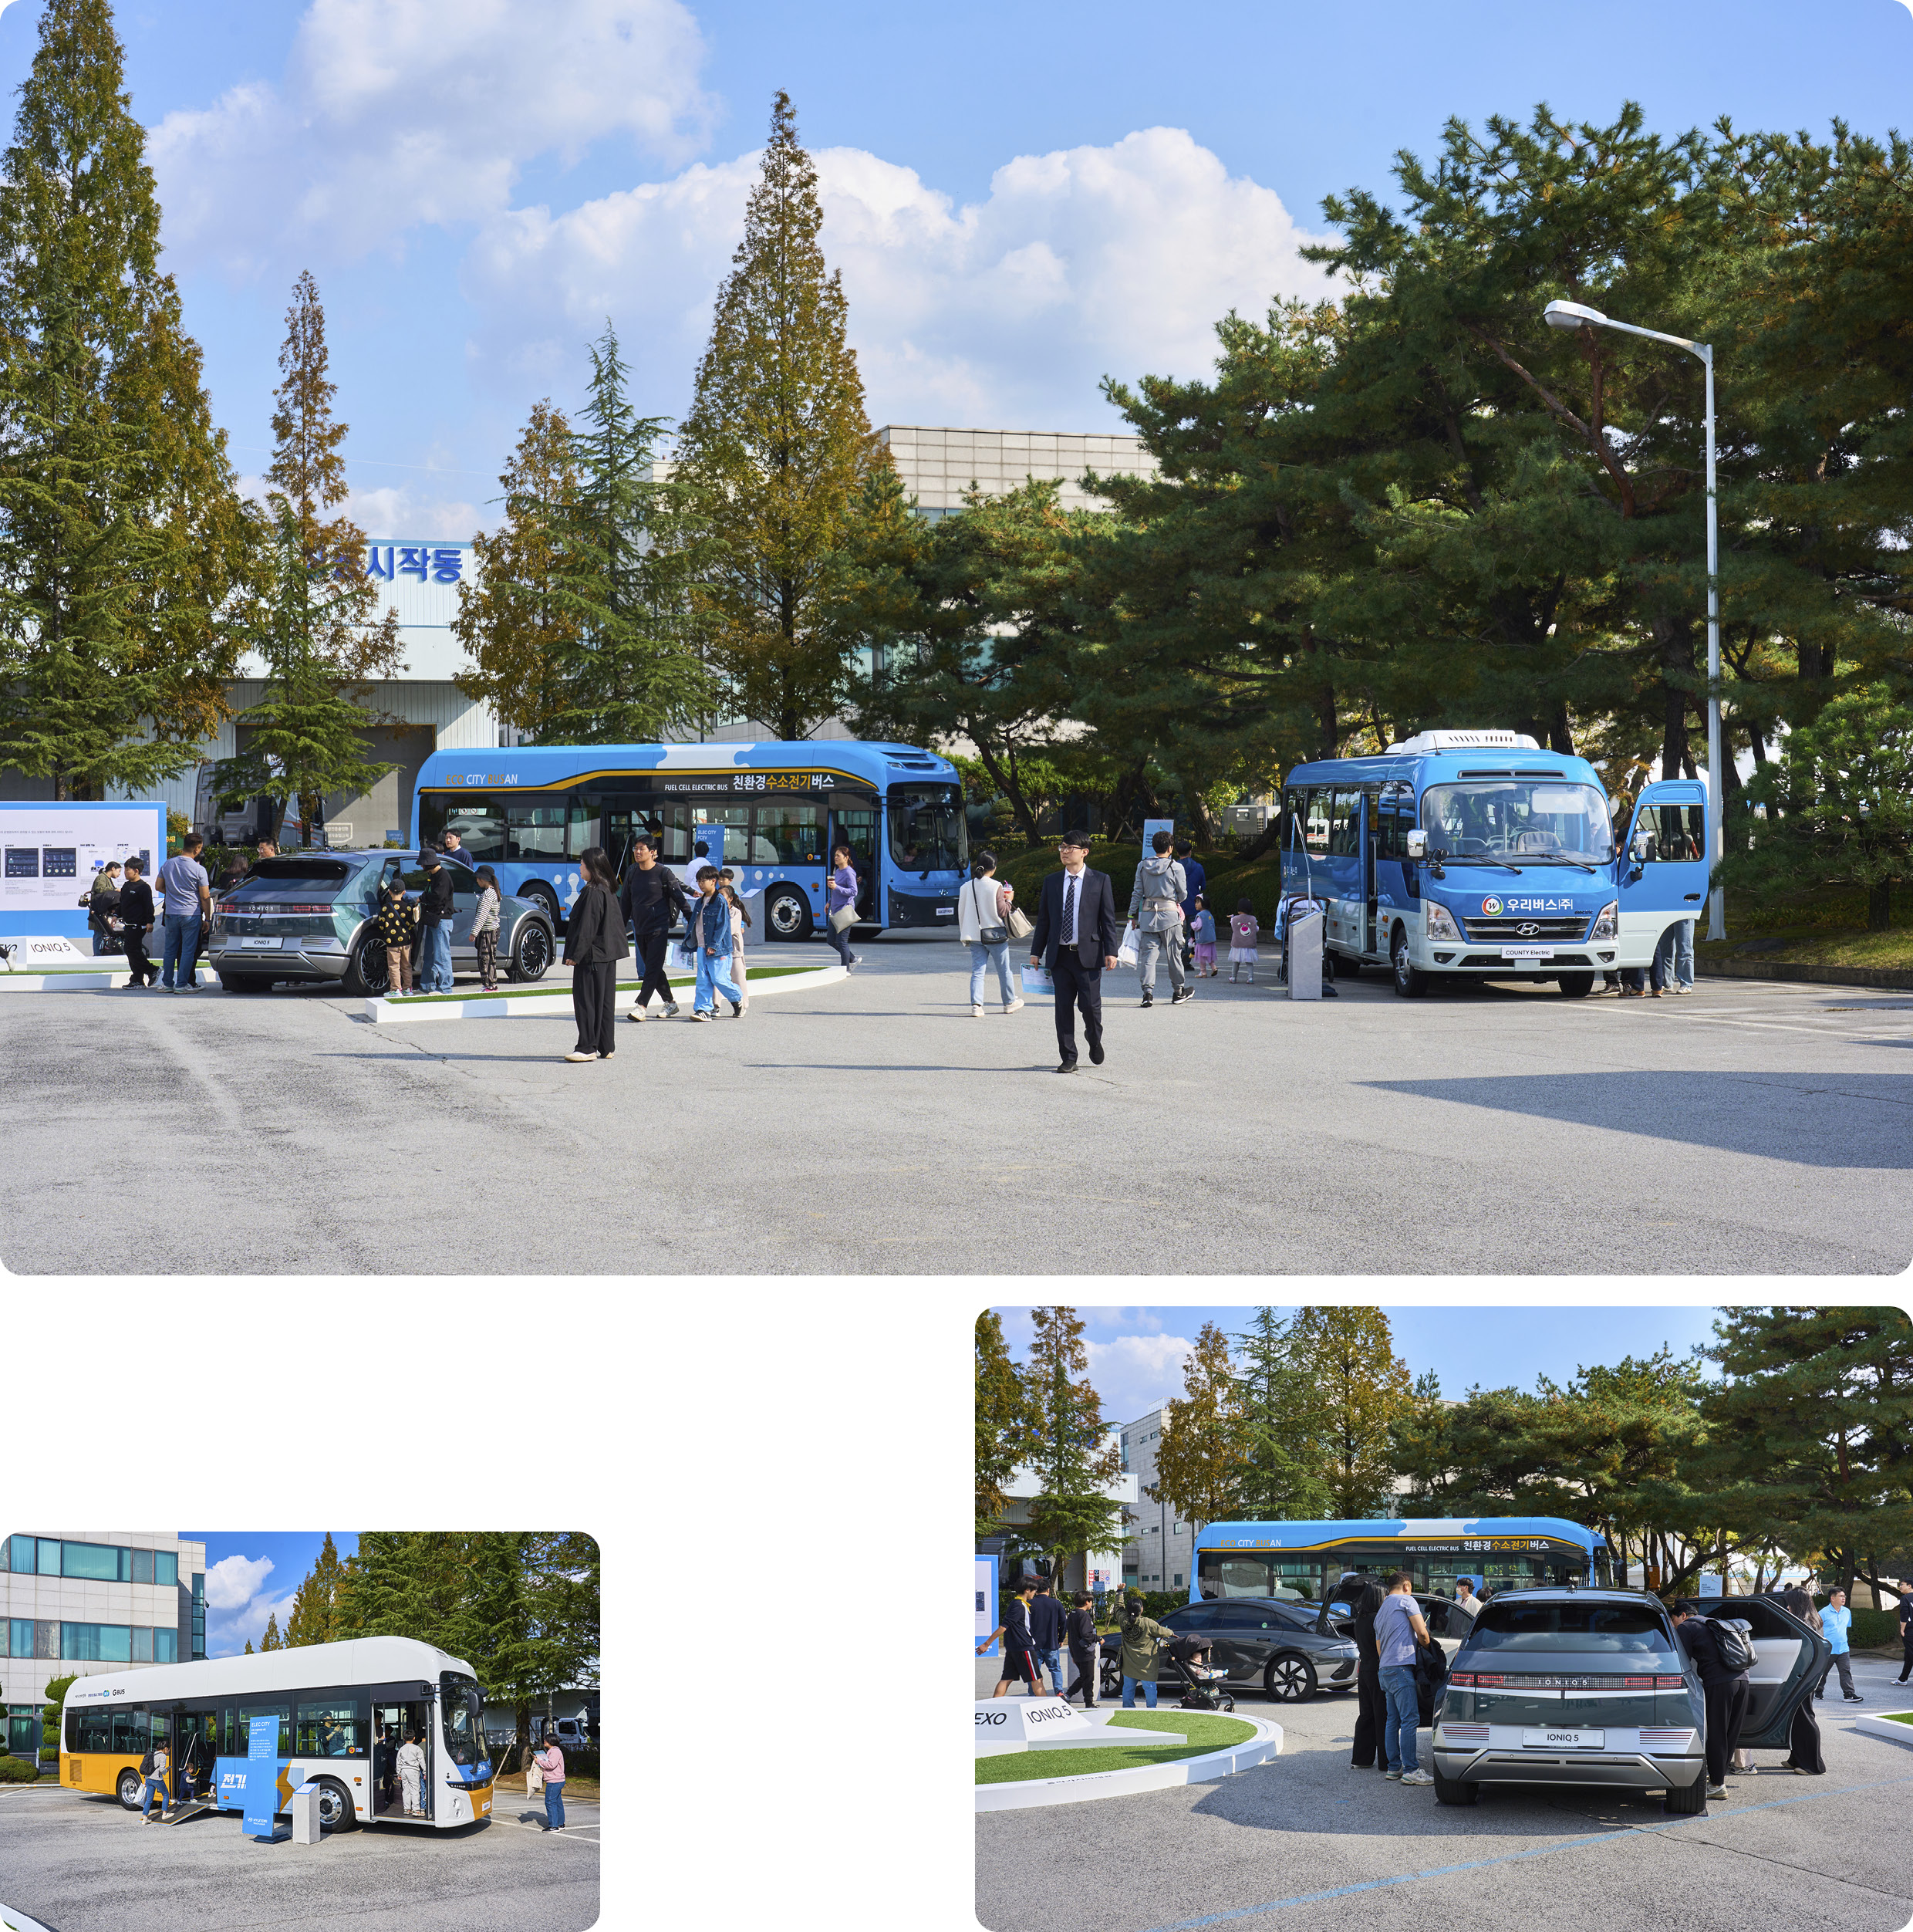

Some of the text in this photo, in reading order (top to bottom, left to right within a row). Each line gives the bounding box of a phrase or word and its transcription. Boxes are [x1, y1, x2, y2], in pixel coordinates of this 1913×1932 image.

[446, 774, 518, 785] ECO CITY BUSAN
[30, 942, 71, 953] IONIQ 5
[1026, 1705, 1071, 1724] IONIQ 5
[1547, 1734, 1572, 1742] IONIQ
